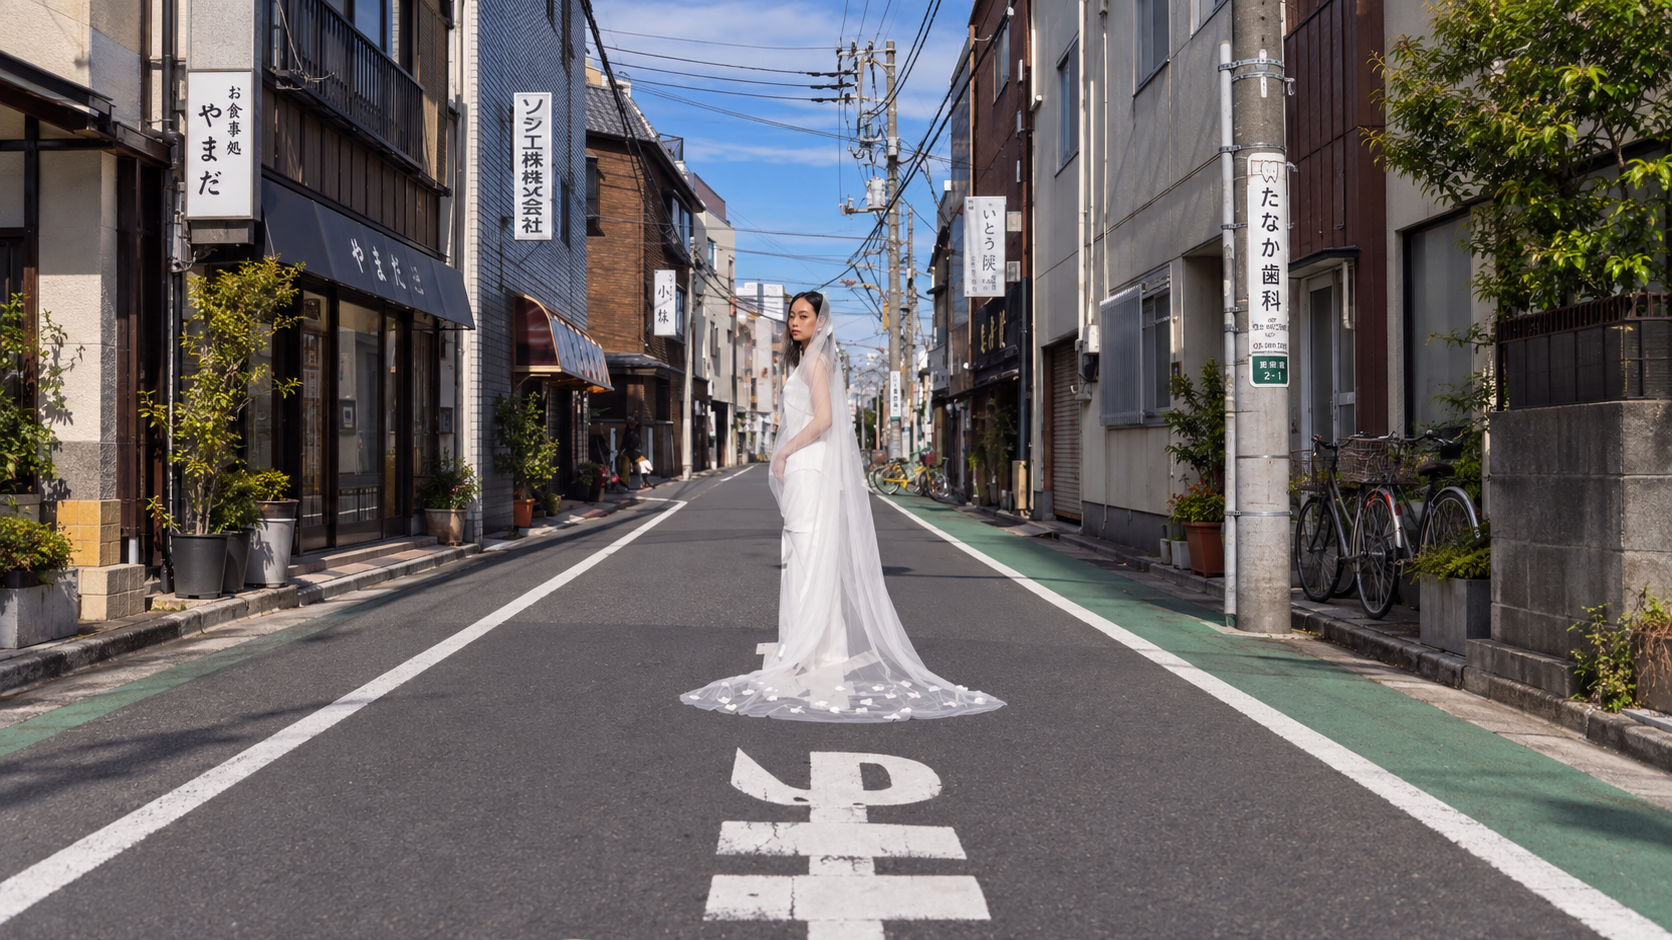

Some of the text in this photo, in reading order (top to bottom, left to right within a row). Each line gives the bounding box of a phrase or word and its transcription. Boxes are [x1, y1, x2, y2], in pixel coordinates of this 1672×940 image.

[198, 103, 222, 195] やまだ
[226, 85, 243, 155] お食事処
[1261, 187, 1281, 312] たなか歯科
[1264, 371, 1282, 381] 2-1
